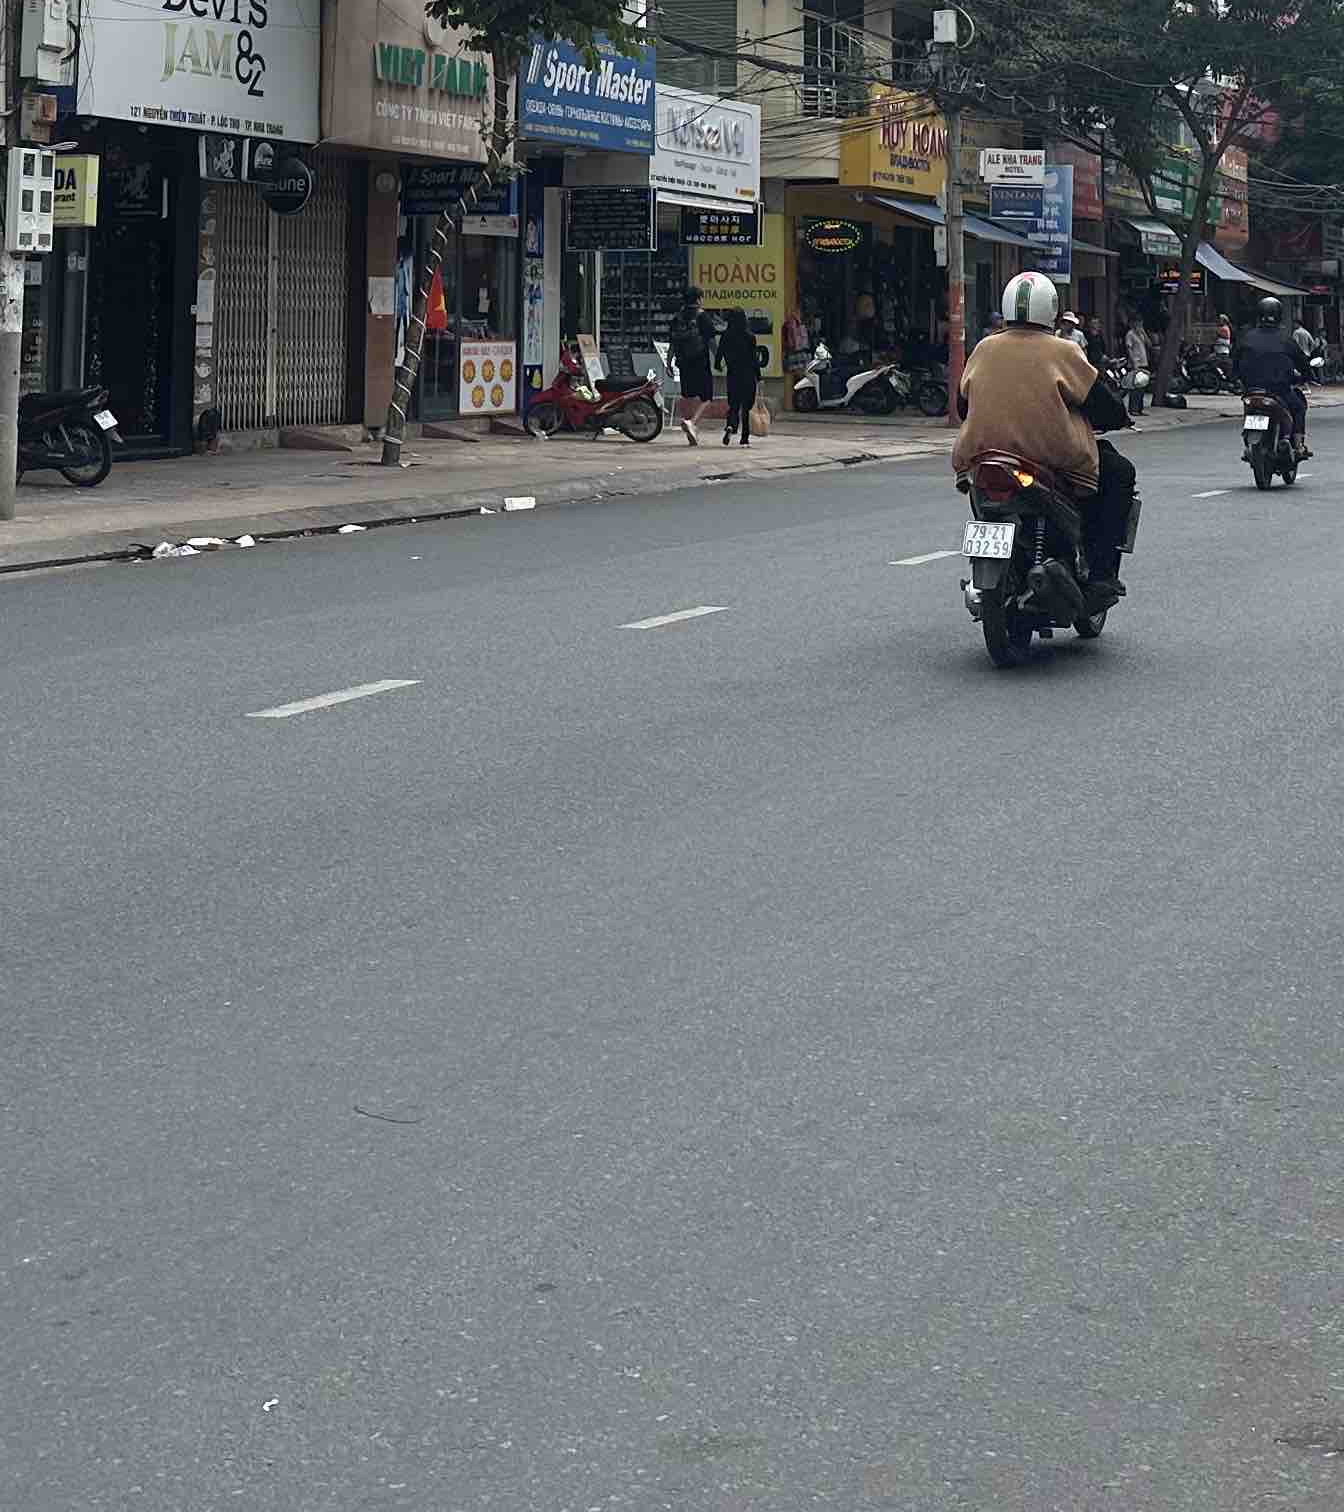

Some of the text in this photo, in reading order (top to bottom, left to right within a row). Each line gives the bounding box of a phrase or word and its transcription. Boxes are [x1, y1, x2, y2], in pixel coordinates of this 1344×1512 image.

[160, 23, 236, 83] JAM
[543, 46, 652, 106] Sport Master
[987, 153, 1001, 166] ALE
[698, 255, 777, 284] HOÀNG
